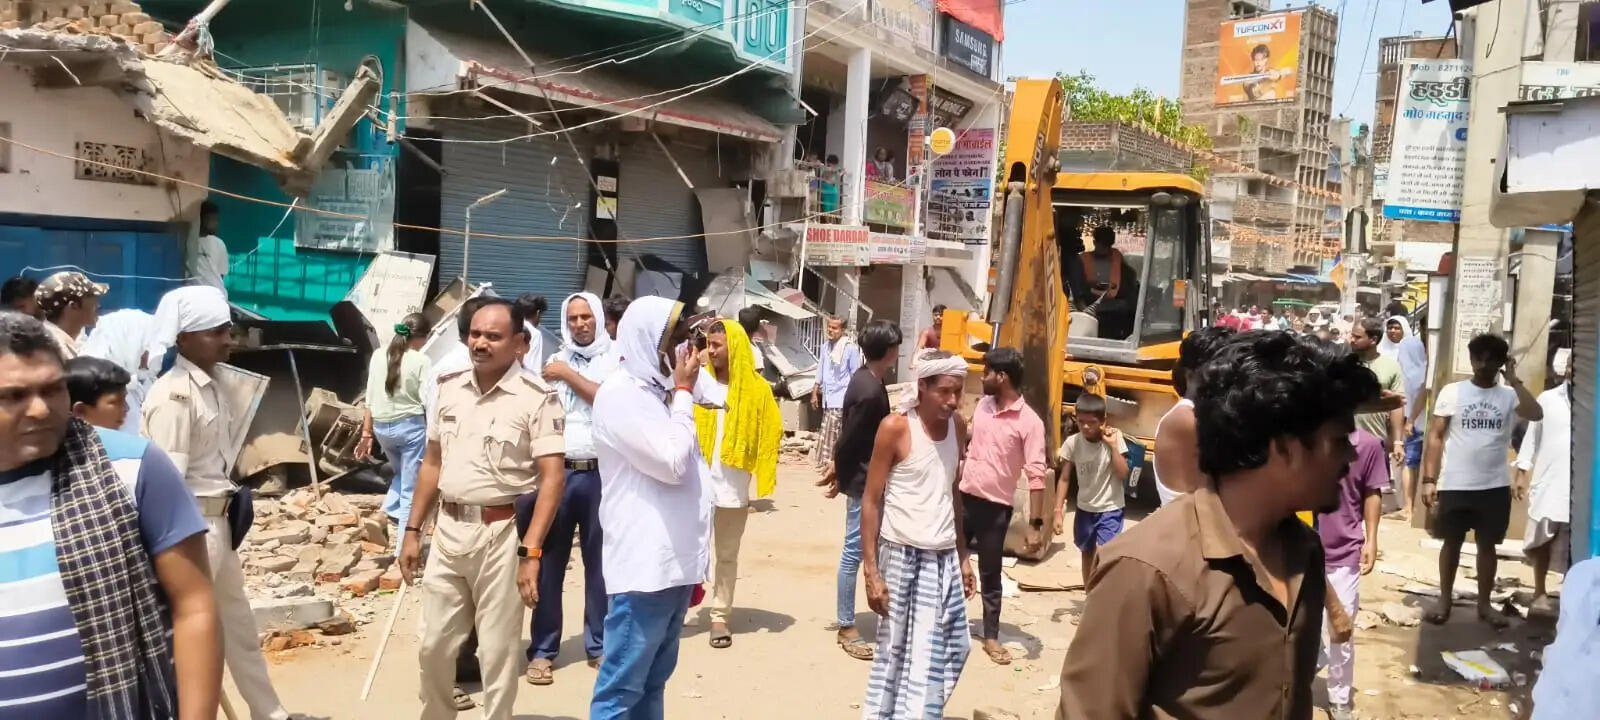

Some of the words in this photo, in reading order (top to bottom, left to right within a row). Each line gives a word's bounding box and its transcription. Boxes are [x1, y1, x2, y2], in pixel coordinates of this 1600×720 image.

[955, 28, 987, 56] SAMSUNG
[806, 228, 831, 243] SHOE
[1461, 418, 1502, 430] FISHING
